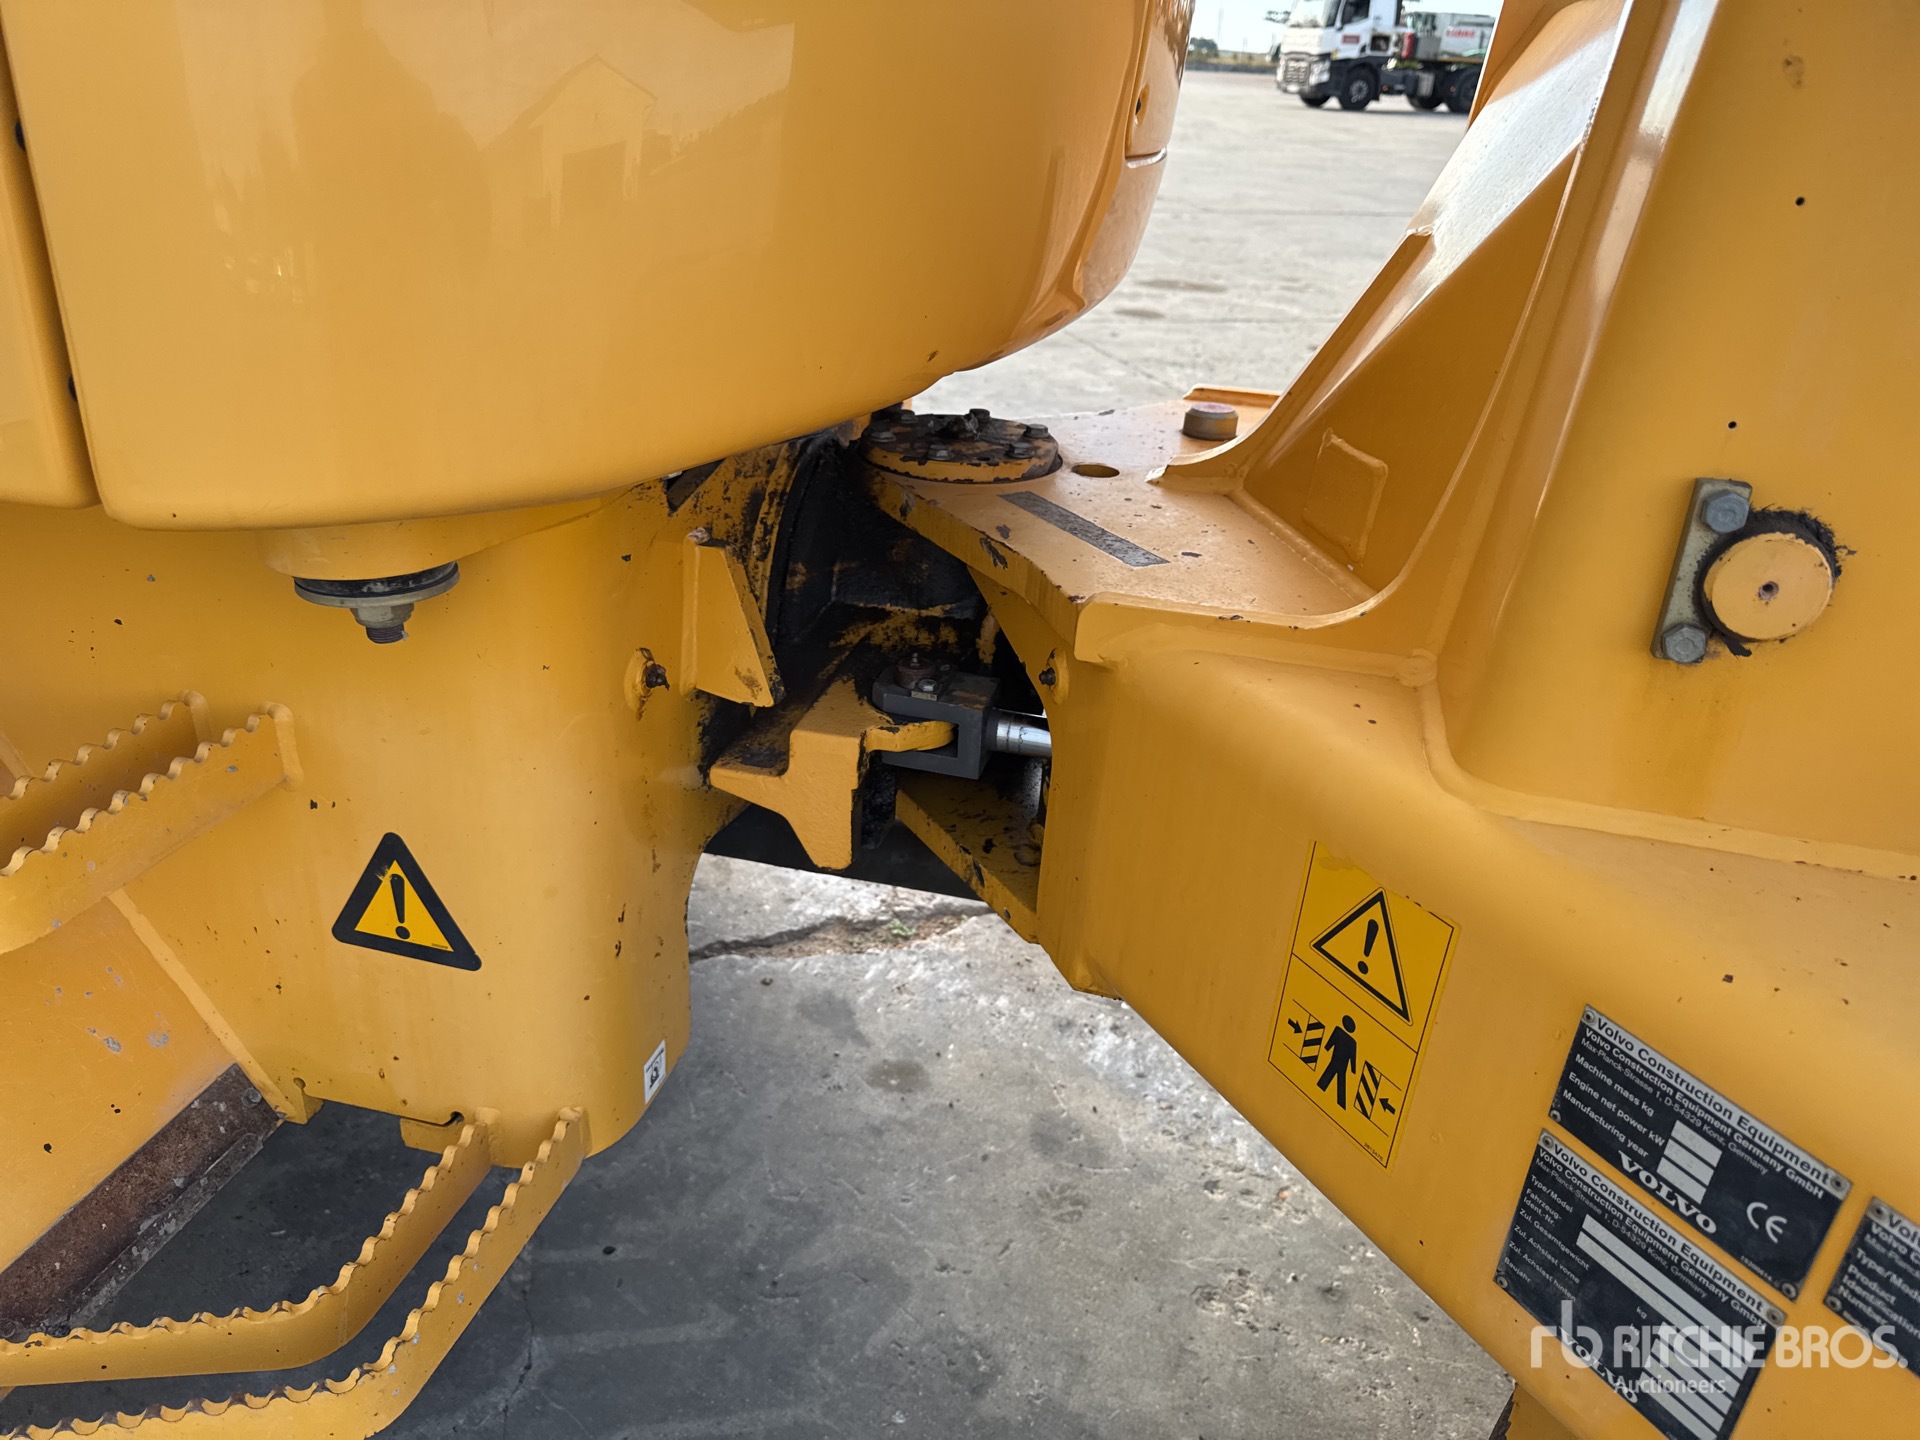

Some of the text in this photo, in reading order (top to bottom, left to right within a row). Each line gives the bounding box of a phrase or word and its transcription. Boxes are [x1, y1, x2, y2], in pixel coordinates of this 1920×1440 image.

[1568, 1071, 1666, 1147] Engine net power kW
[1575, 1053, 1655, 1118] Machine mass kg
[1581, 1037, 1654, 1093] Max-Planck-Strasse
[1664, 1096, 1702, 1127] D-54329
[1728, 1142, 1769, 1175] Germany
[1585, 1027, 1824, 1199] Volvo Construction Equipment Germany GmbH
[1597, 1018, 1830, 1185] Volvo Construction Equipment
[1562, 1089, 1649, 1158] Manufacturing year
[1526, 1188, 1562, 1220] Fahrzeug-
[1531, 1174, 1574, 1213] Type/Model
[1535, 1157, 1602, 1215] Max-Planck-Strasse
[1612, 1218, 1647, 1250] D-54329
[1617, 1149, 1717, 1234] VOLVO
[1746, 1201, 1788, 1244] CE
[1519, 1208, 1590, 1271] Zul. Gesamtgewicht
[1527, 1237, 1559, 1266] Achslast
[1559, 1263, 1580, 1284] vorne
[1539, 1148, 1564, 1172] Volvo
[1564, 1169, 1624, 1220] Construction
[1624, 1217, 1680, 1264] Equipment
[1680, 1260, 1729, 1303] Germany
[1730, 1300, 1767, 1331] GmbH
[1553, 1143, 1764, 1313] Volvo Construction Equipment
[1871, 1221, 1908, 1255] Volvo
[1888, 1213, 1920, 1250] Vol
[1504, 1256, 1531, 1283] Baujahr
[1522, 1253, 1554, 1282] Achslast
[1553, 1279, 1577, 1302] hinten
[1847, 1264, 1897, 1306] Product
[1558, 1325, 1638, 1404] VOLVO
